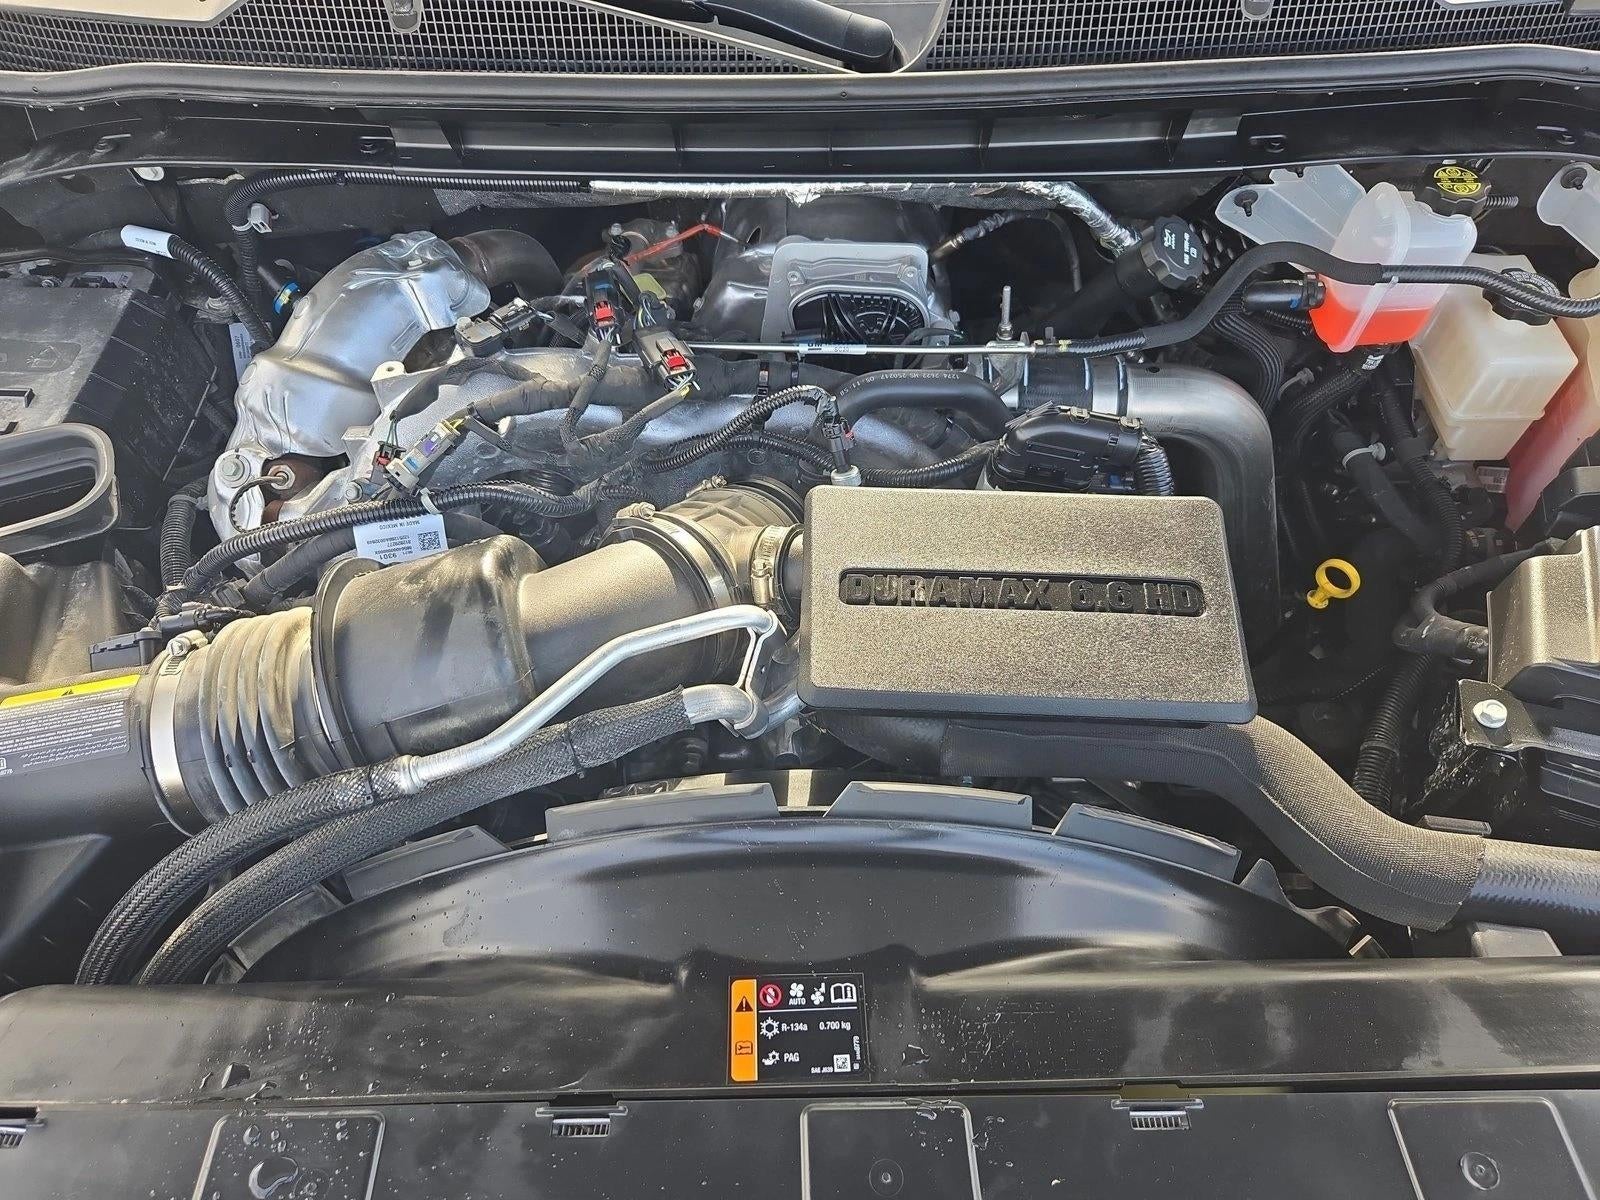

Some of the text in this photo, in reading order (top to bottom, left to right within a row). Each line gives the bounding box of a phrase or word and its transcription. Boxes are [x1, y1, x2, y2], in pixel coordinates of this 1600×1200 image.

[846, 573, 1200, 615] DURAMAX 6.6 HD
[788, 997, 806, 1005] AUTO
[781, 1021, 851, 1032] R-134a 0.700 kg
[783, 1052, 800, 1062] PAG
